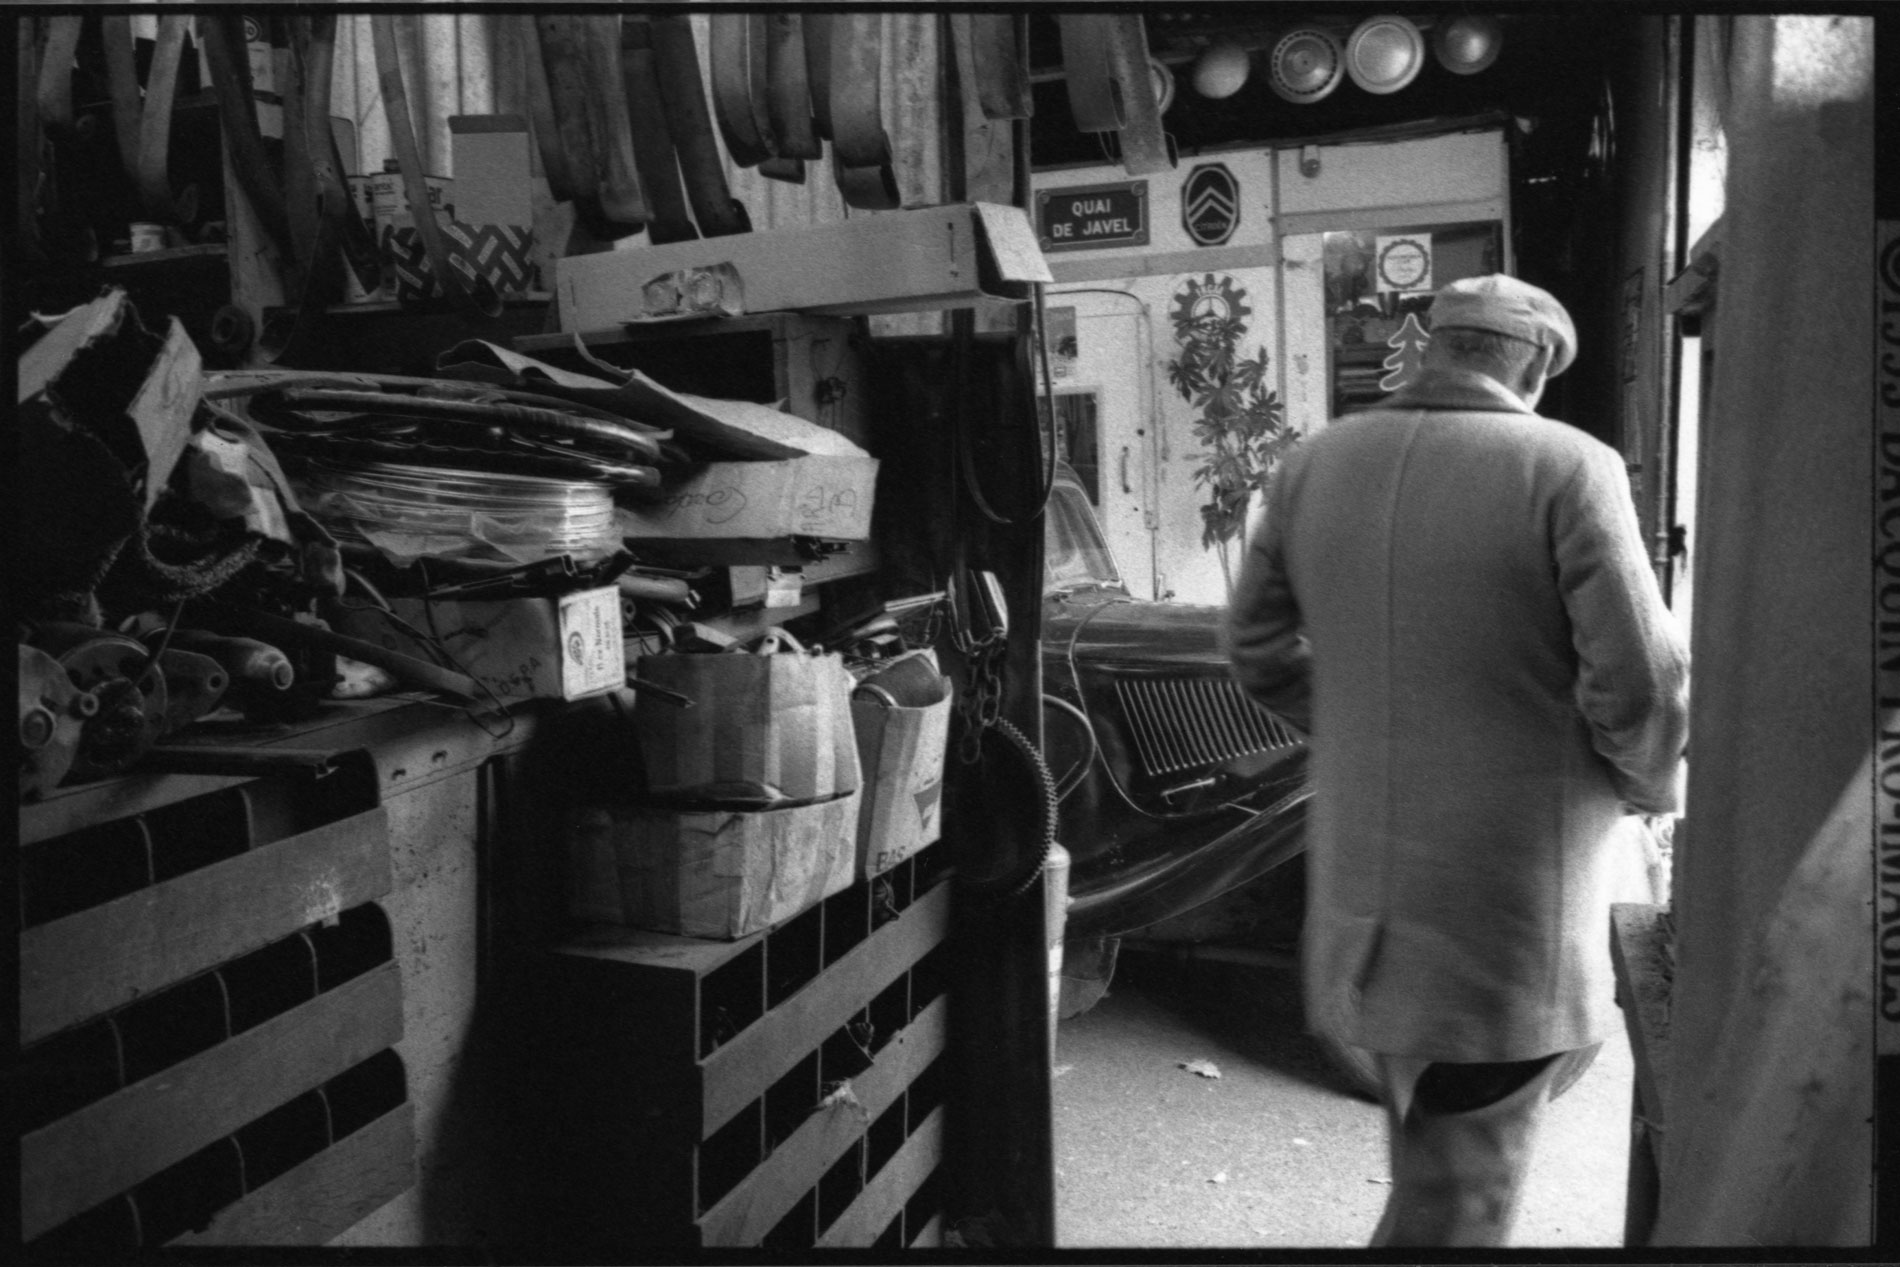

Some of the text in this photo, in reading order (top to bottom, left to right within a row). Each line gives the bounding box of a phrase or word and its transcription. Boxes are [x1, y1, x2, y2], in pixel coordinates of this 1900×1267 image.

[1072, 198, 1111, 218] QUAI
[1052, 217, 1132, 238] DE JAVEL
